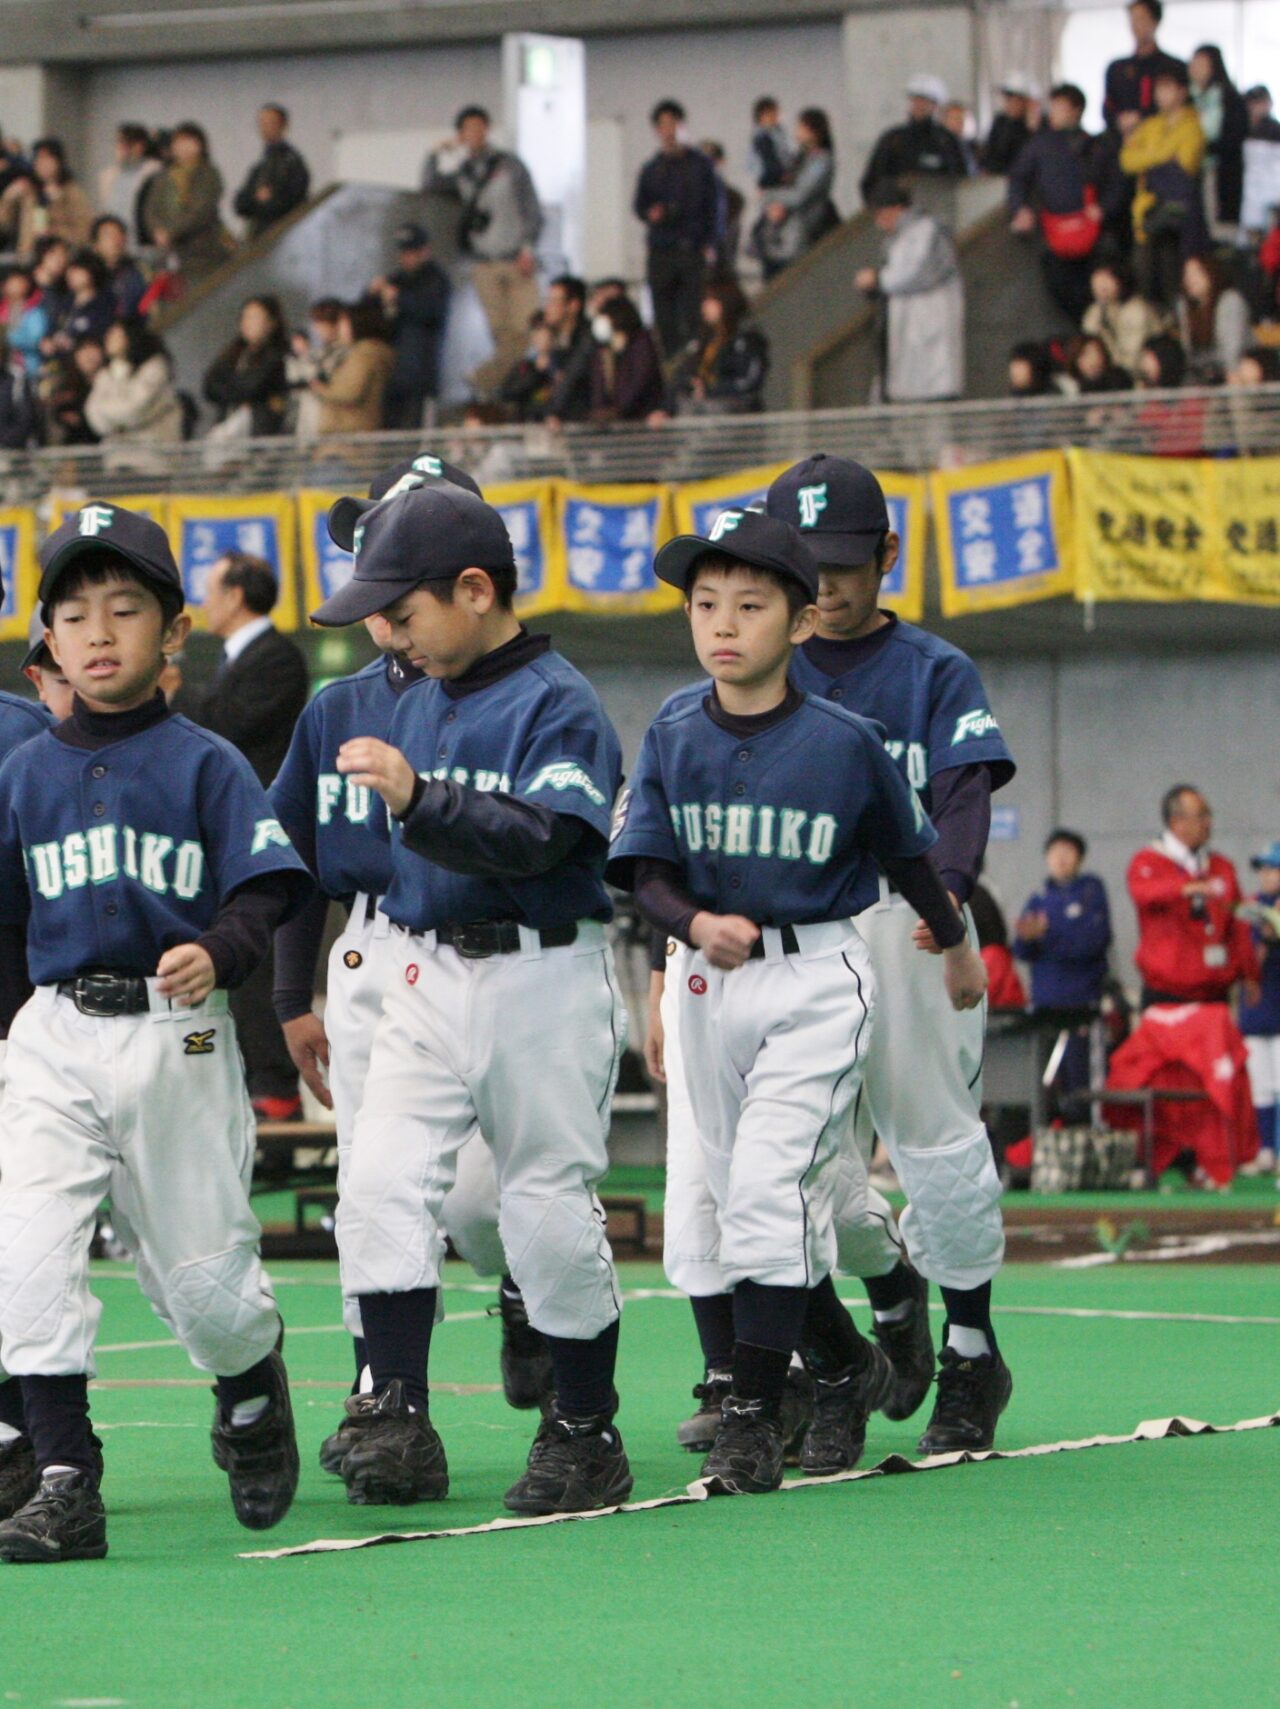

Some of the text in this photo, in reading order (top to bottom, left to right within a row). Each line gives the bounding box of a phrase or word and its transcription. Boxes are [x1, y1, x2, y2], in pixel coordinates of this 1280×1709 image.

[79, 504, 115, 537] F
[797, 482, 828, 528] F
[707, 510, 744, 541] F
[23, 823, 205, 901] USHIKO
